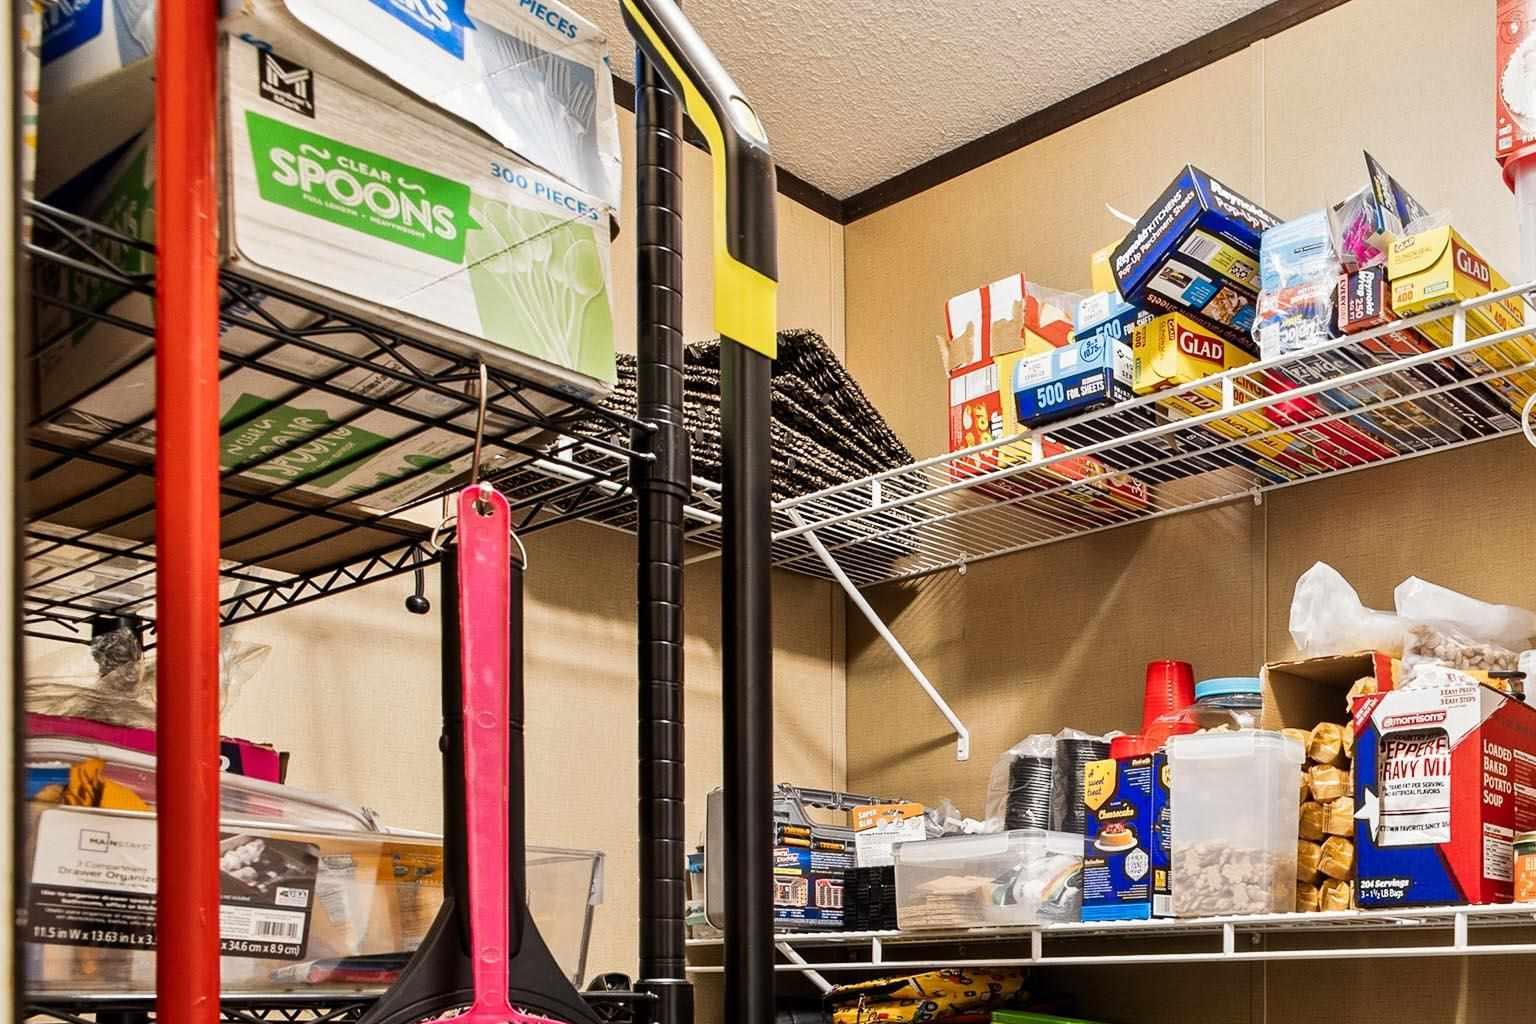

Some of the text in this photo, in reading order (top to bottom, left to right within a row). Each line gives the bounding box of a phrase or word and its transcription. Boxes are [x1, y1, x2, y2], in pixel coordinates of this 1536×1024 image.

[336, 154, 392, 184] CLEAR
[269, 146, 457, 241] SPOONS
[489, 162, 600, 221] 300 PIECES
[1456, 252, 1490, 283] GLAD
[1354, 297, 1364, 320] 250
[1179, 332, 1224, 361] GLAD
[1037, 380, 1105, 409] 500 FOIL SHEETS
[1483, 739, 1513, 763] LOADED
[1424, 757, 1450, 777] MI
[1483, 756, 1508, 777] BAKED
[1483, 773, 1512, 794] POTATO
[1483, 790, 1504, 807] SOUP
[33, 926, 56, 938] 11.5
[57, 928, 67, 938] in
[69, 929, 81, 940] W
[82, 931, 88, 940] x
[91, 930, 118, 942] 13.63
[119, 932, 129, 942] in
[229, 940, 249, 952] 34.6
[270, 943, 284, 954] 8.9
